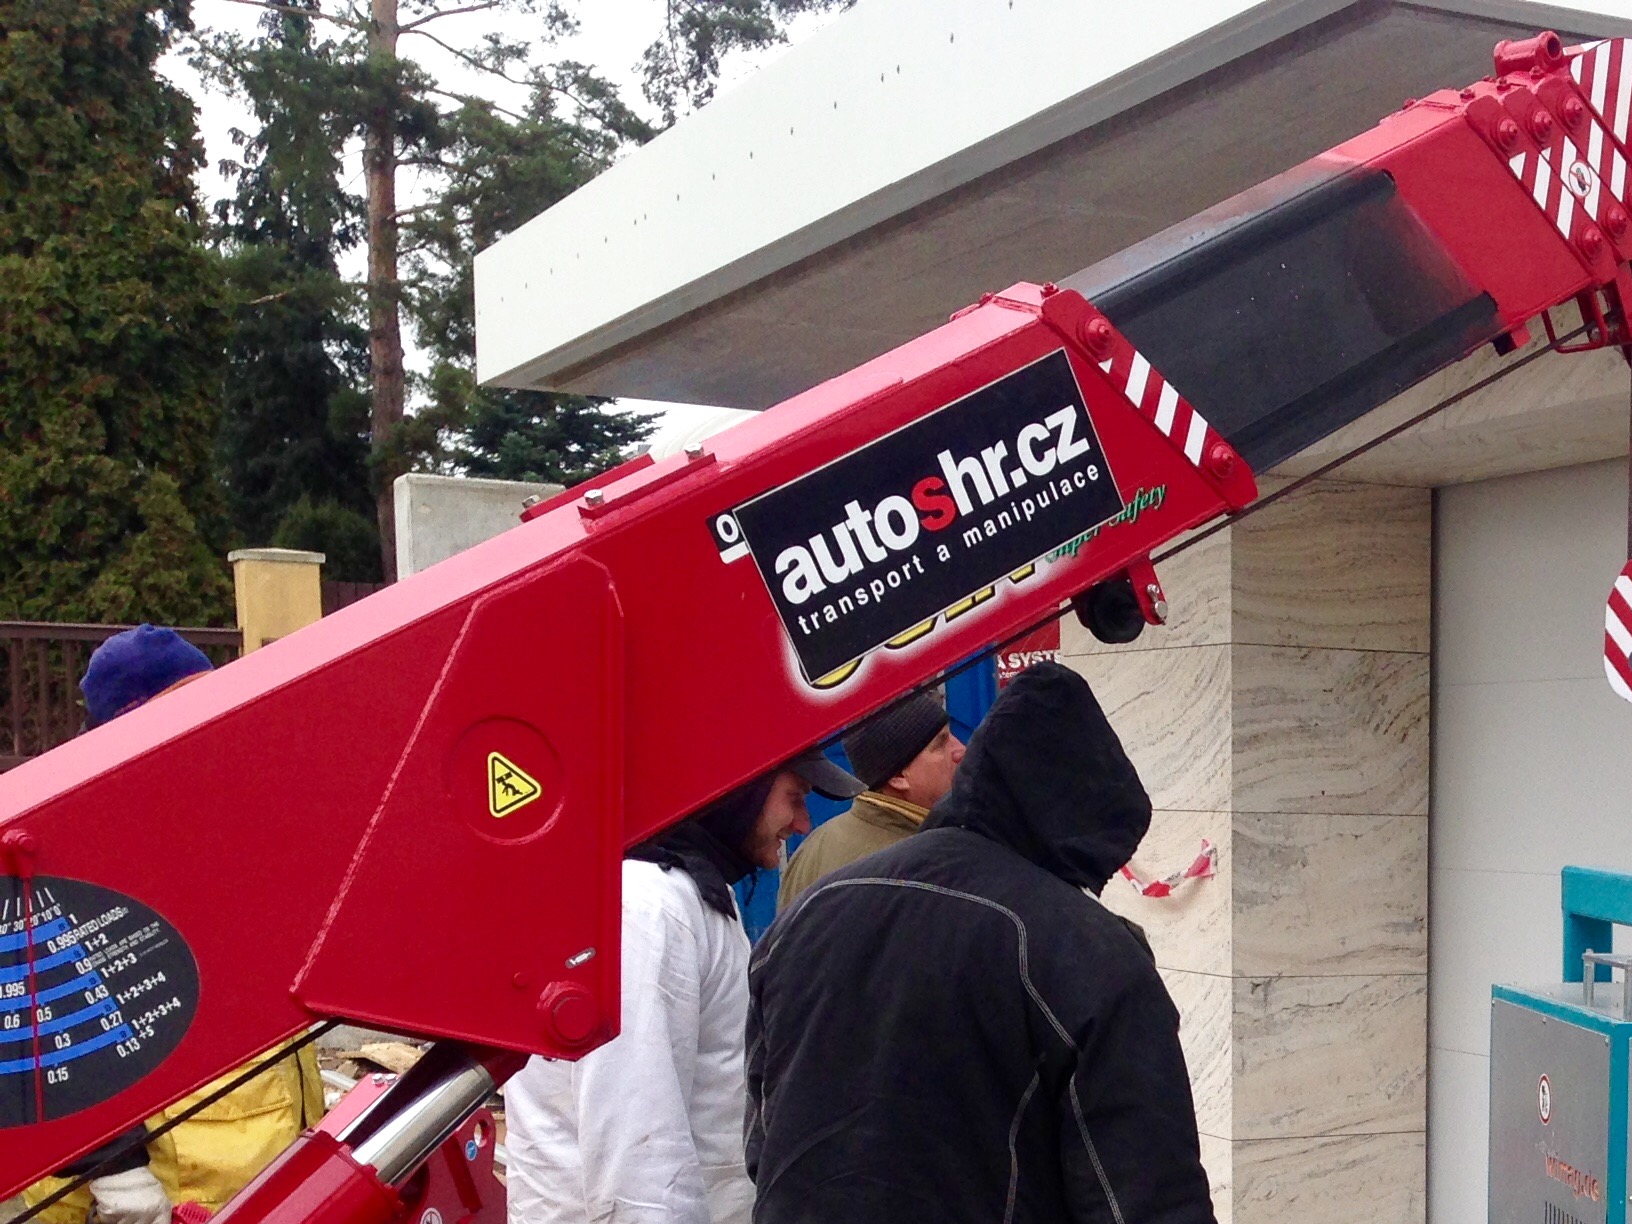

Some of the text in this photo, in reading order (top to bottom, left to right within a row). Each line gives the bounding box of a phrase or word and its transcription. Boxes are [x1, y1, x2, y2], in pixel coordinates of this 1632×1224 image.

[774, 405, 1090, 604] autoshr.cz
[797, 554, 925, 635] transport
[936, 544, 951, 562] a
[962, 462, 1100, 548] manipulace
[72, 919, 99, 940] RATED
[97, 906, 124, 927] LOADS
[84, 932, 109, 951] 1+2
[101, 952, 137, 978] 1+2+3
[84, 984, 109, 1004] 0.43
[116, 970, 166, 1005] 1+2+3+4
[4, 1013, 20, 1029] 0.6
[36, 1006, 52, 1022] 0.5
[100, 1010, 123, 1031] 0.27
[131, 996, 182, 1030] 1+2+3+4
[54, 1033, 71, 1049] 0.3
[116, 1037, 141, 1058] 0.13
[47, 1066, 69, 1084] 0.15
